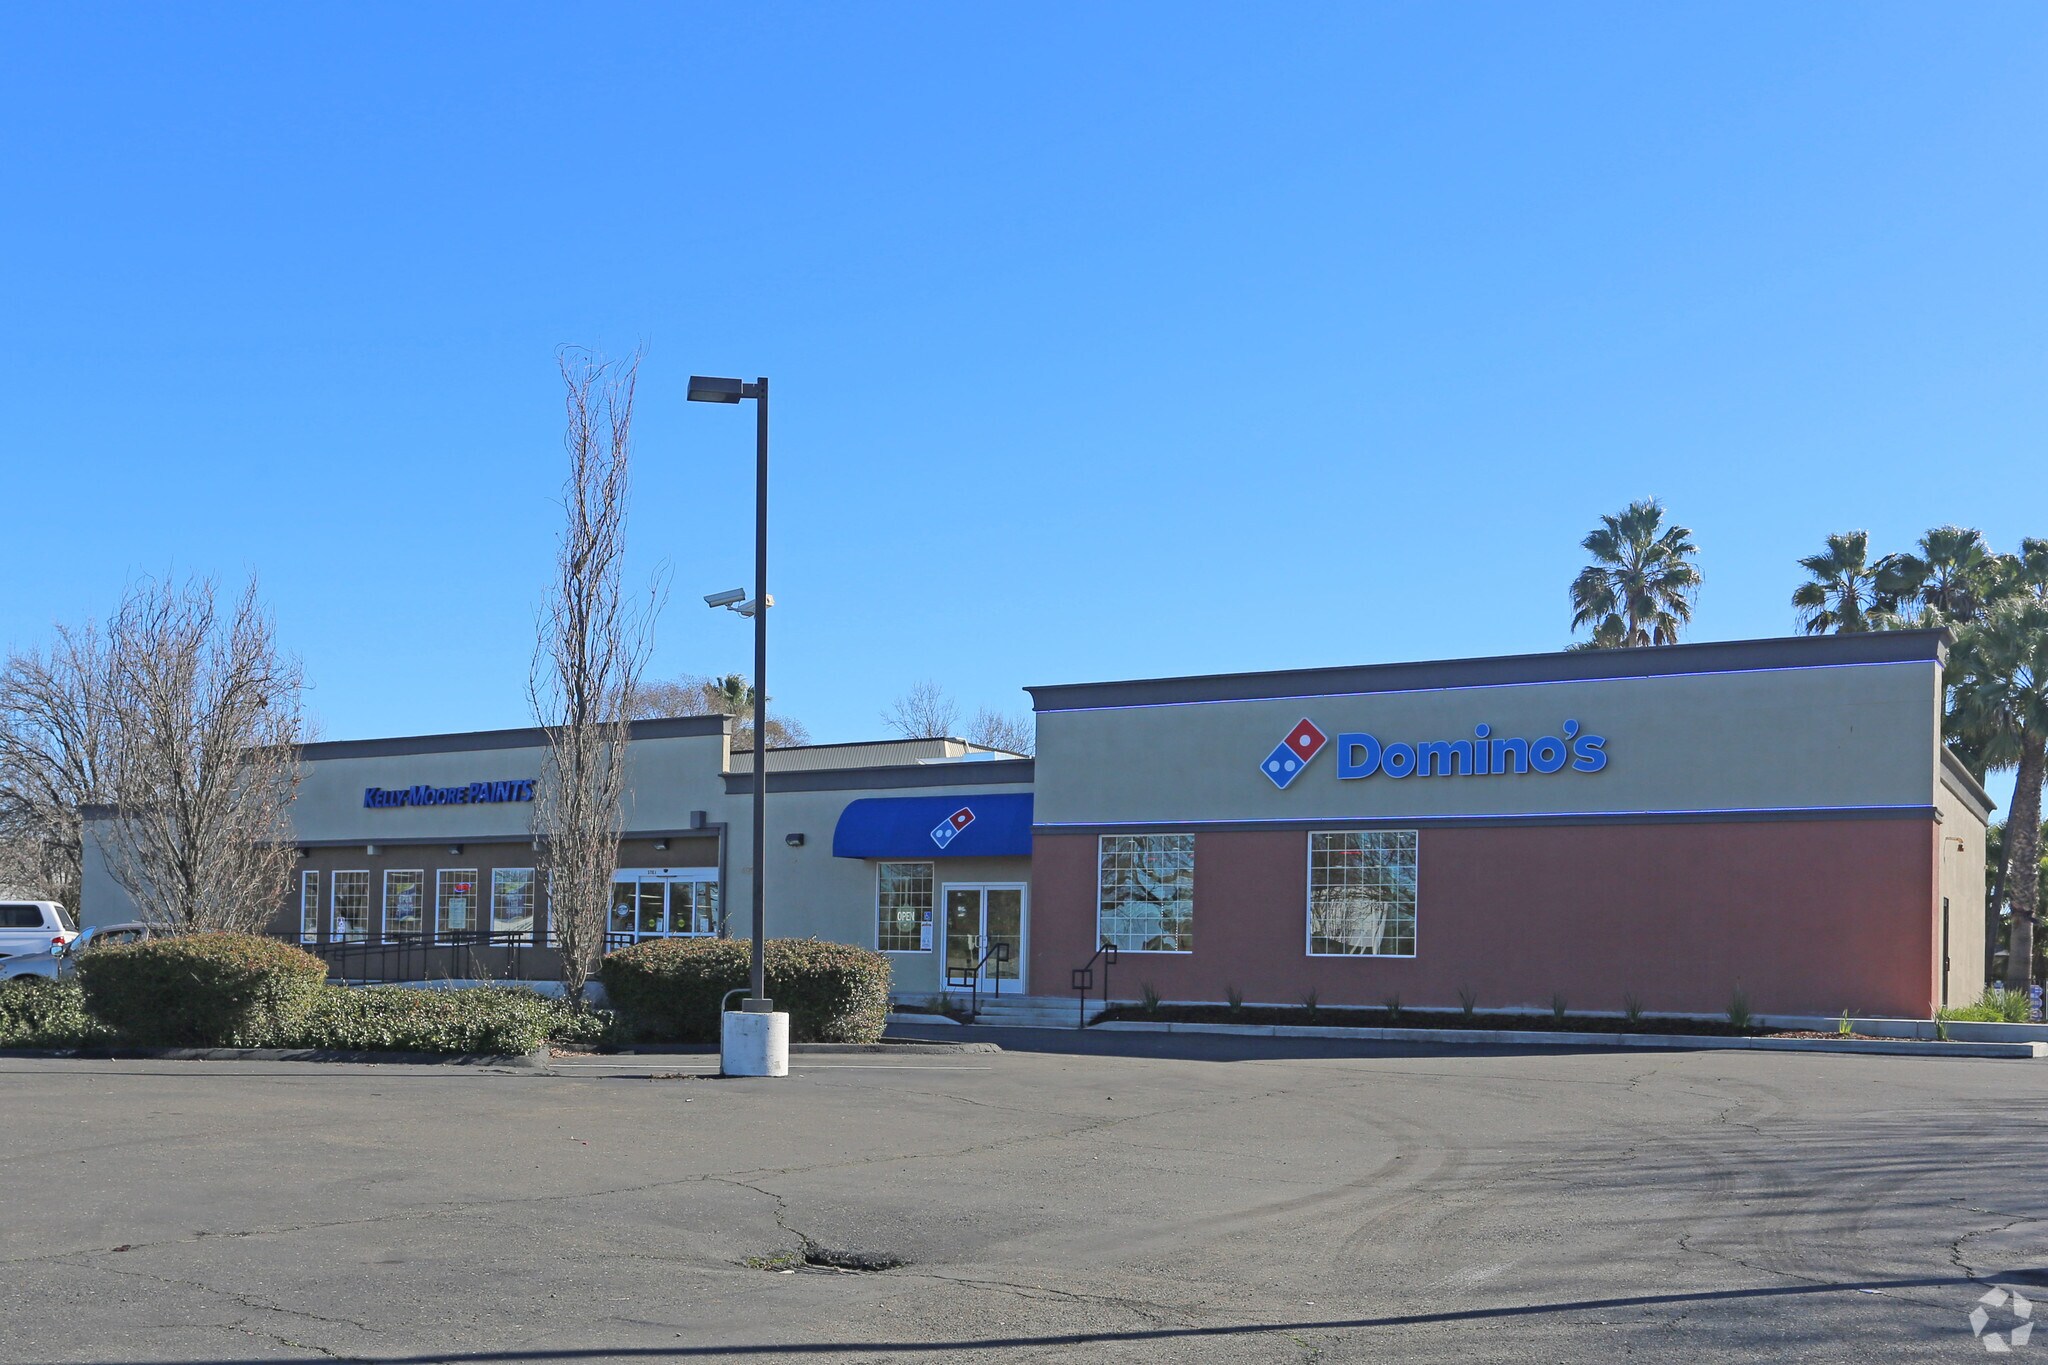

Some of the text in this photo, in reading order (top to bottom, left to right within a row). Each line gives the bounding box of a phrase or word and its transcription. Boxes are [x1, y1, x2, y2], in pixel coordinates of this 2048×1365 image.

[1337, 719, 1607, 780] Domino's
[468, 779, 534, 803] PAINTS
[897, 911, 915, 921] OPEN
